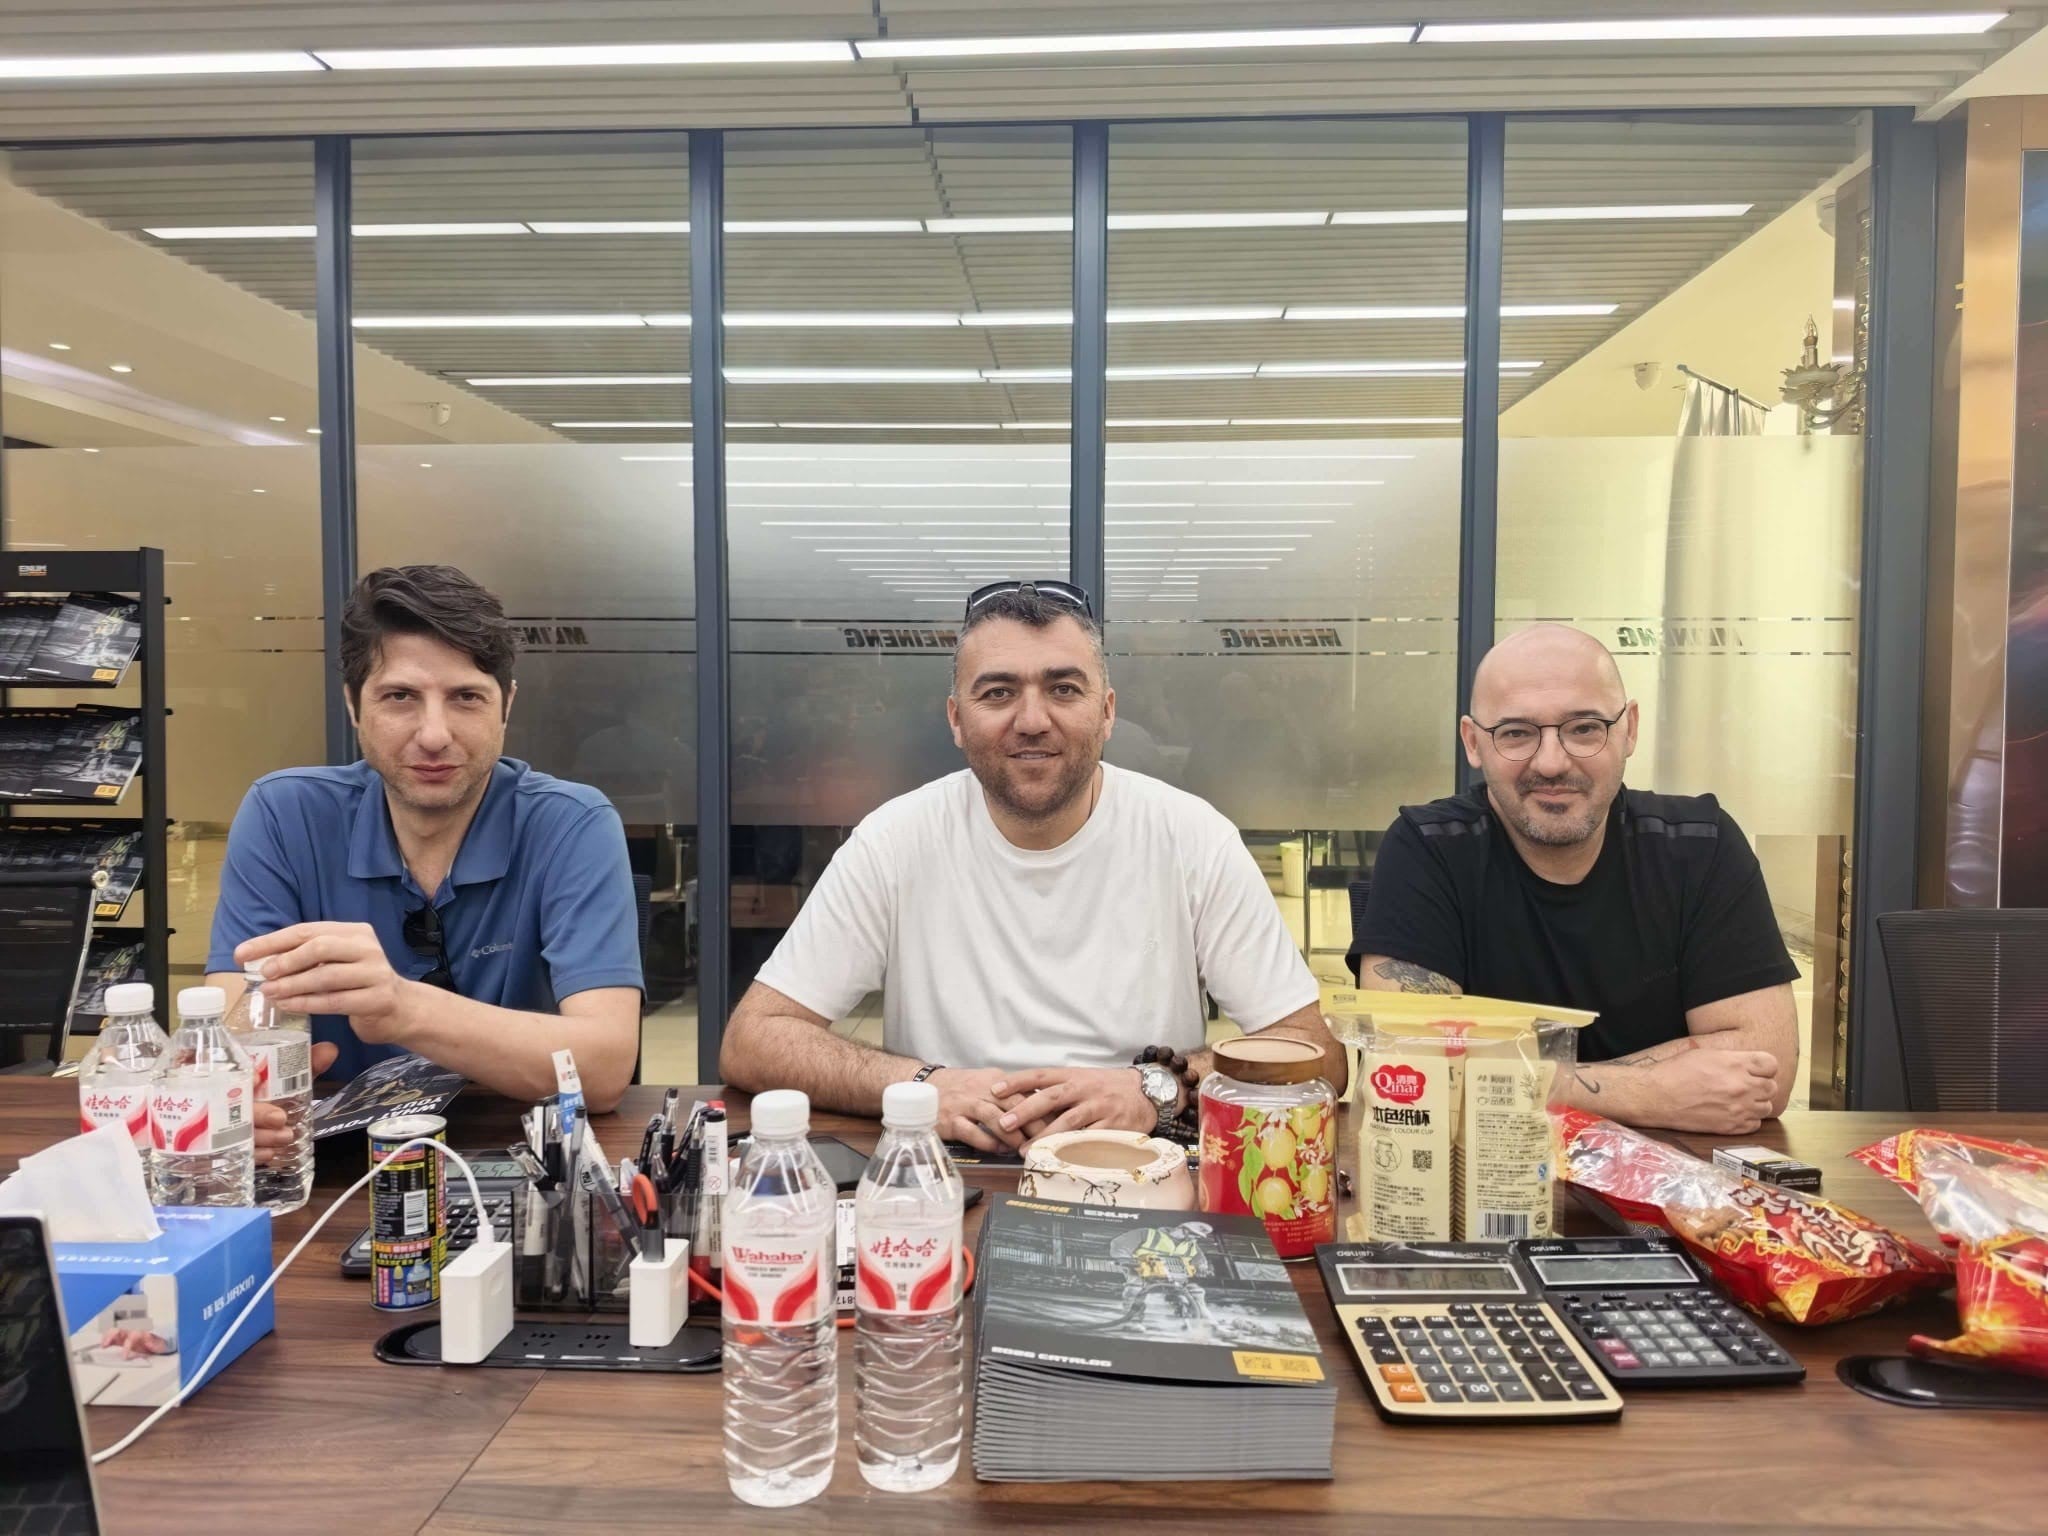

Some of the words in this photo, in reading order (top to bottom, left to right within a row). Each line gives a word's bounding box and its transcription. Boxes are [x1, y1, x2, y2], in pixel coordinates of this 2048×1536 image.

[1375, 1072, 1419, 1094] Qinar
[84, 1094, 131, 1110] 娃哈哈
[152, 1095, 193, 1112] 娃哈哈
[1372, 1106, 1431, 1126] 本色纸杯
[313, 1115, 375, 1137] POWE
[731, 1246, 804, 1263] Wahaha
[870, 1236, 935, 1258] 娃哈哈
[1037, 1352, 1113, 1368] CATALOG
[1389, 1365, 1407, 1374] CE
[1431, 1365, 1439, 1374] 1
[1464, 1365, 1474, 1374] 2
[1498, 1365, 1509, 1374] 3
[1400, 1384, 1417, 1393] AC
[1440, 1384, 1450, 1393] 0
[1470, 1384, 1490, 1393] 00
